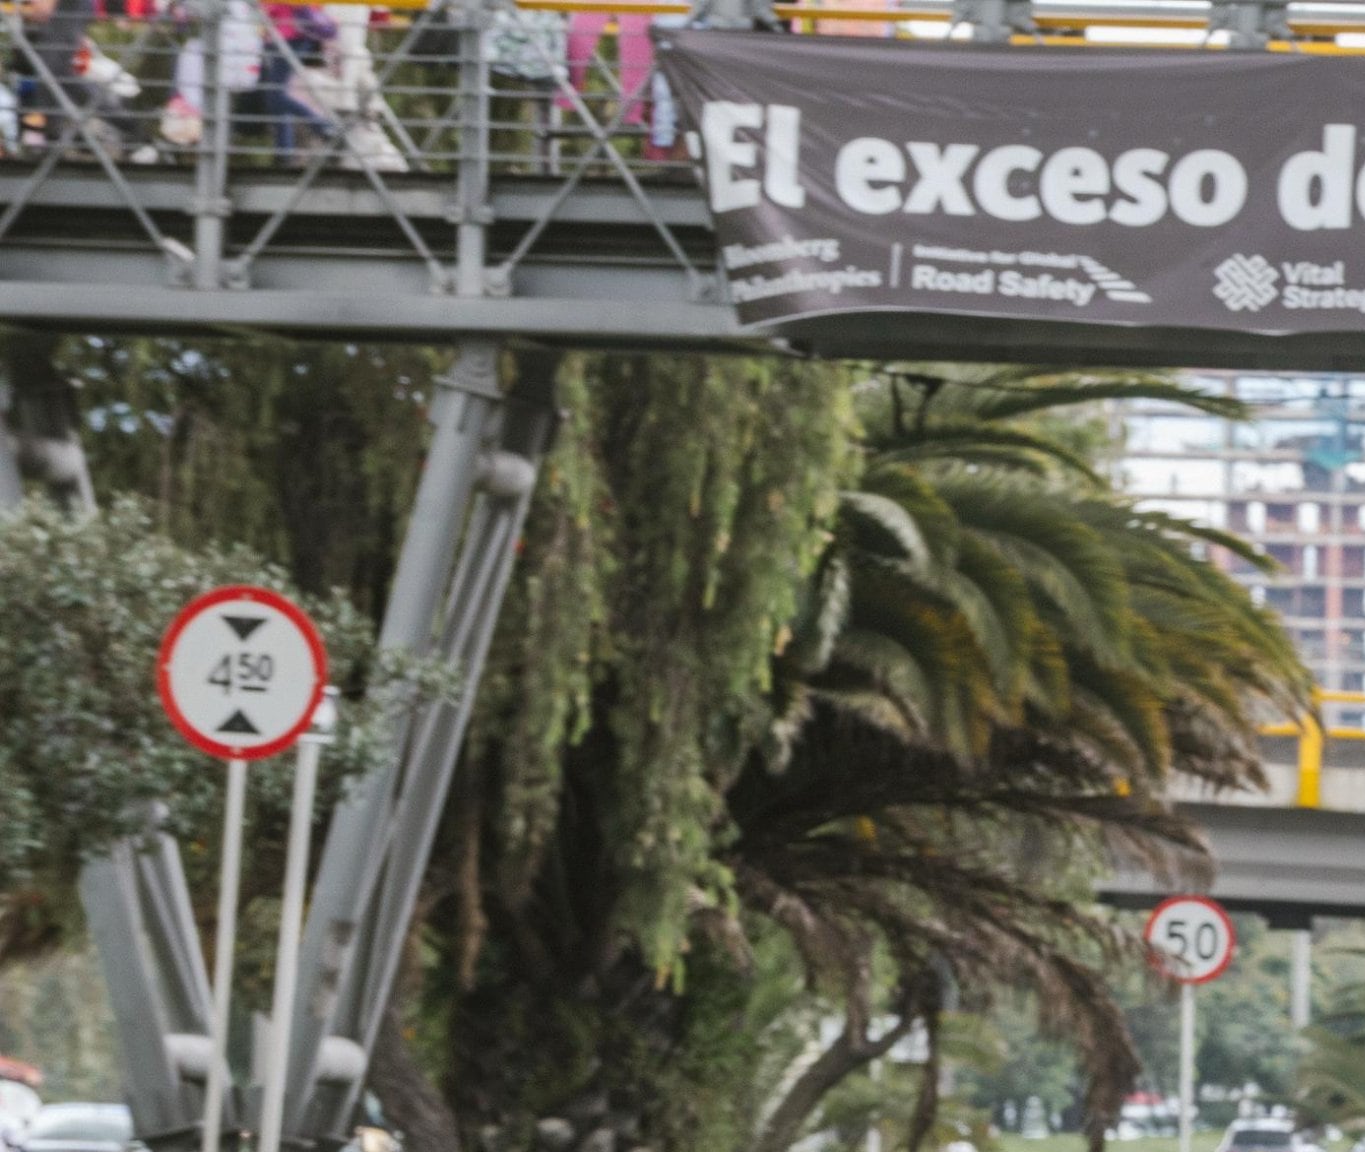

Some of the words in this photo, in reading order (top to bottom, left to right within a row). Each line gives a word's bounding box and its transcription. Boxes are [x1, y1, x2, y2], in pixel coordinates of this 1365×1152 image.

[834, 136, 1248, 229] exceso
[912, 264, 995, 294] Road
[998, 269, 1096, 307] Safety
[1282, 260, 1345, 286] Vital
[1167, 920, 1217, 960] 50
